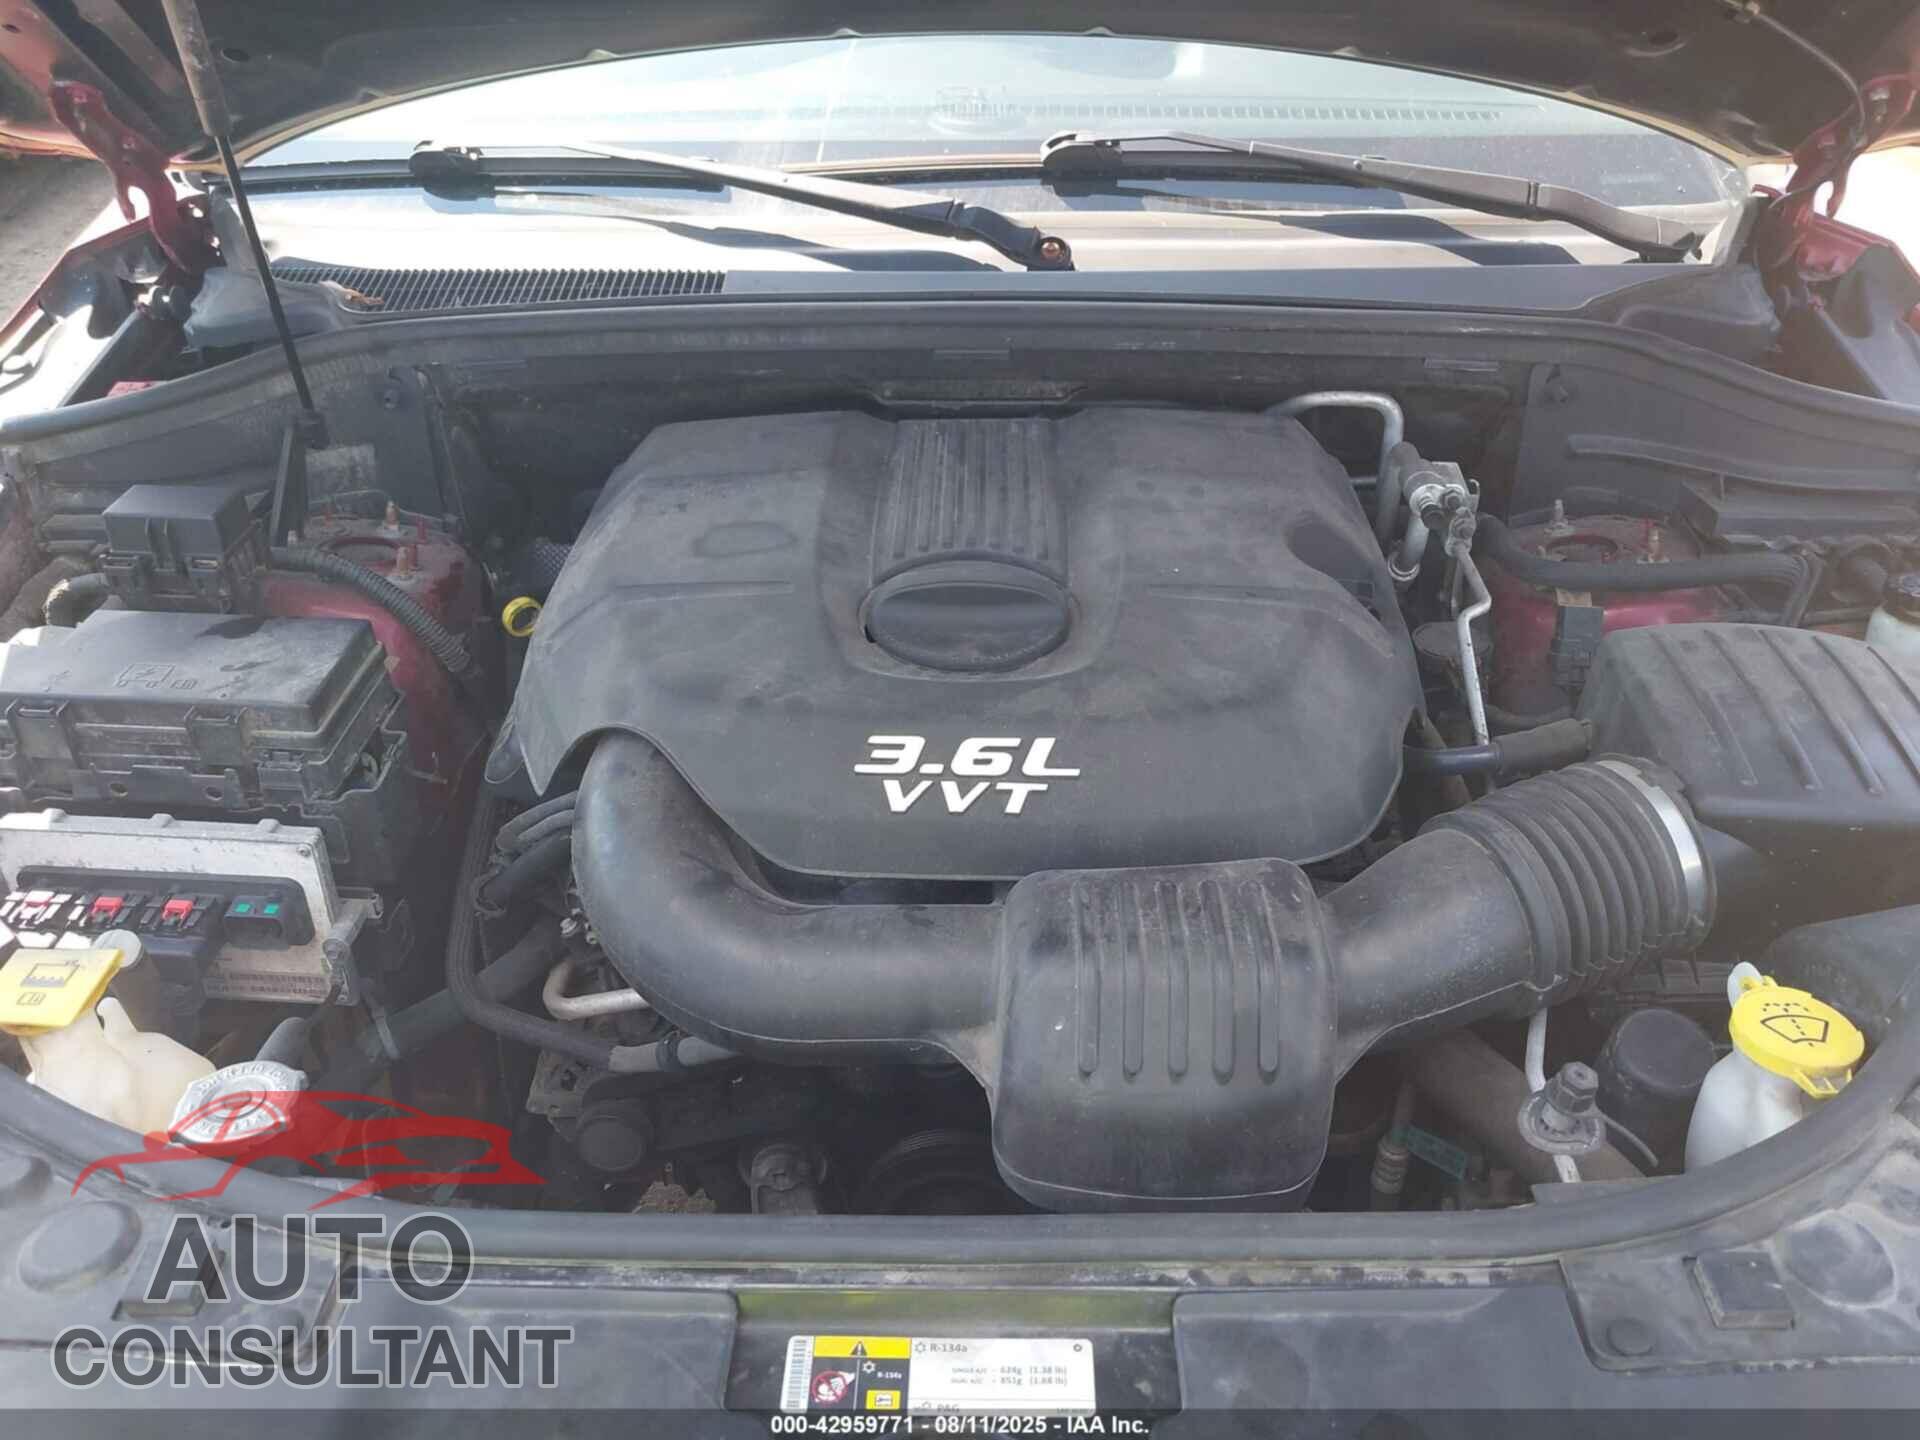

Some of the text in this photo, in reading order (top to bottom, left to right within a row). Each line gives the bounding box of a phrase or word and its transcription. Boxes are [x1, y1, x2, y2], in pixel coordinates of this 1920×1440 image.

[853, 735, 1081, 777] 3.6L
[882, 779, 1049, 814] VVT
[929, 1343, 968, 1353] R-134a
